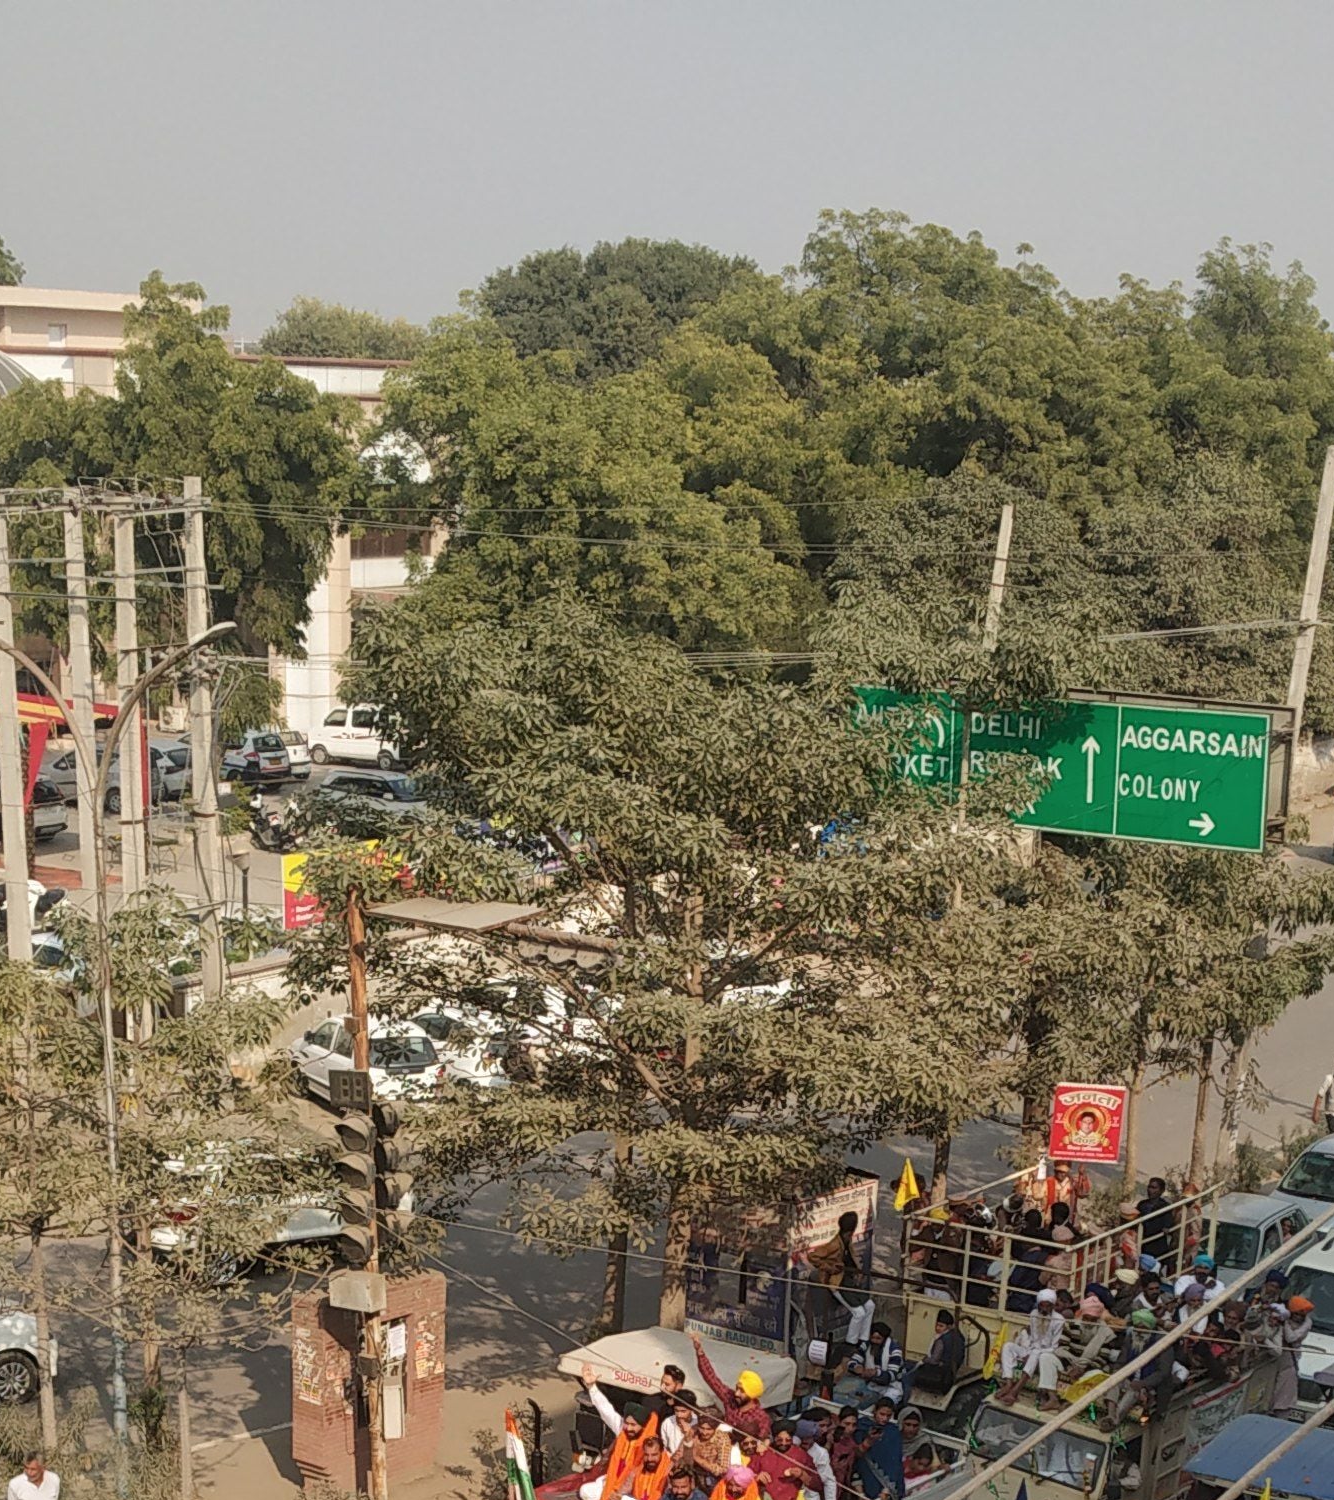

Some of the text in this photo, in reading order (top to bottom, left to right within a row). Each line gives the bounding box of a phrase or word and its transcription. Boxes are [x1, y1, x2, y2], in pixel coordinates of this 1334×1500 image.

[971, 712, 1042, 741] DELHI
[1121, 724, 1265, 759] AGGARSAIN
[1118, 772, 1202, 804] COLONY
[685, 1319, 722, 1340] PUNJAB
[725, 1330, 757, 1348] RADIO
